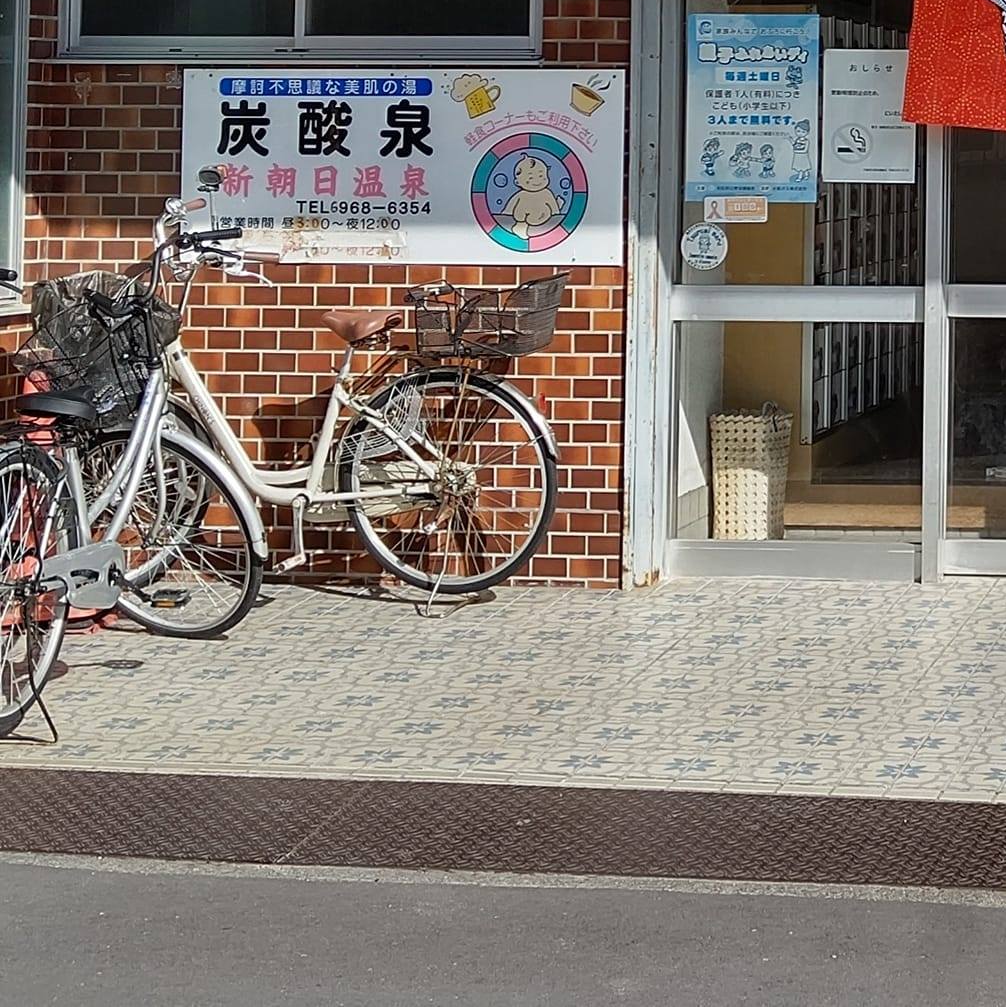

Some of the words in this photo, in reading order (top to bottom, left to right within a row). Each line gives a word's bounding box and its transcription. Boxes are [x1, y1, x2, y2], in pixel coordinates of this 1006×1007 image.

[849, 64, 893, 72] おしらせ
[230, 79, 418, 95] 摩訶不思議な美肌の湯
[216, 99, 434, 158] 炭酸泉
[464, 110, 597, 147] 軽食コーナーもご利用下さい
[221, 163, 430, 200] 新朝日温泉
[220, 217, 274, 229] 営業時間
